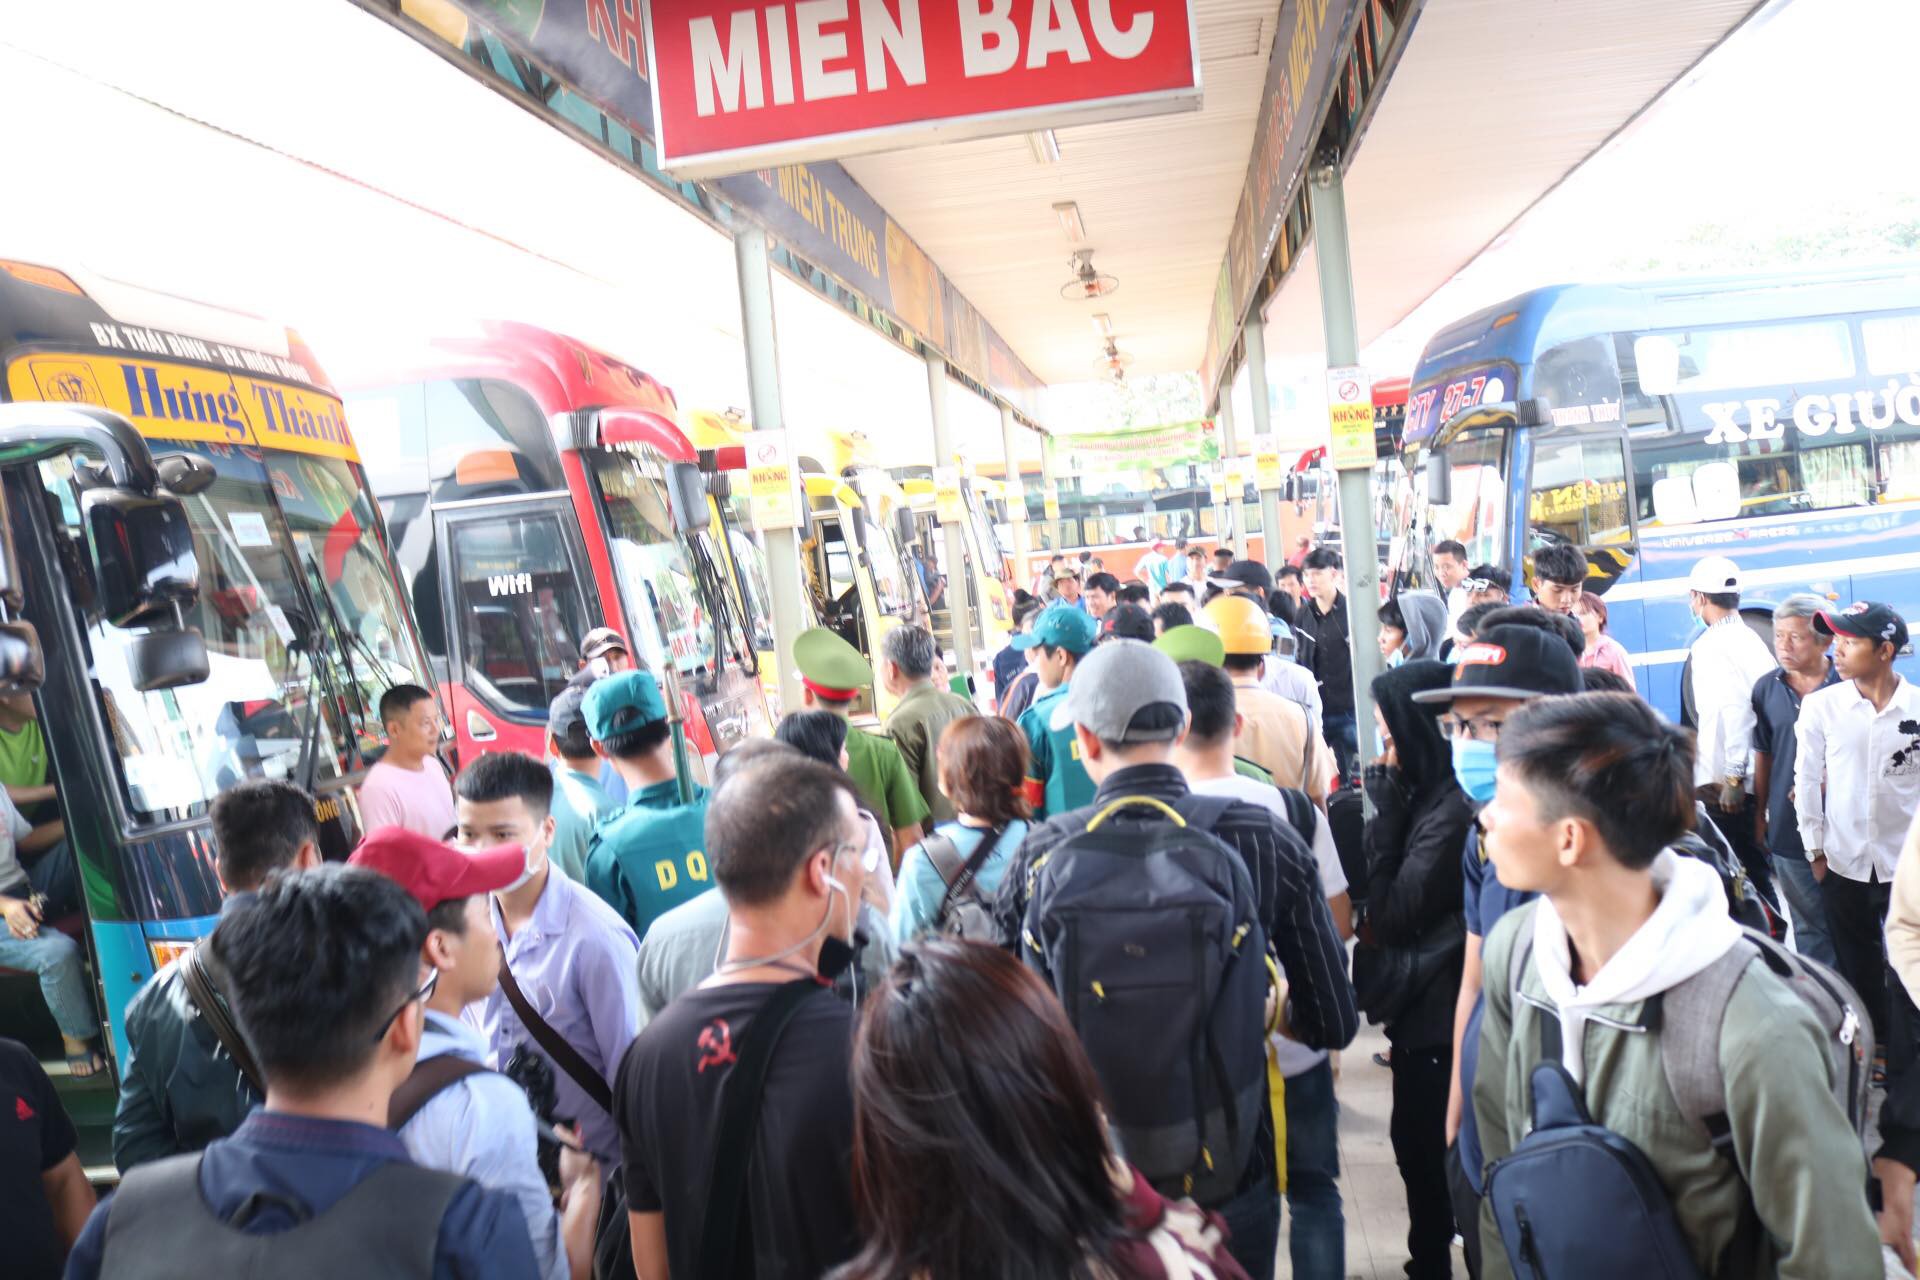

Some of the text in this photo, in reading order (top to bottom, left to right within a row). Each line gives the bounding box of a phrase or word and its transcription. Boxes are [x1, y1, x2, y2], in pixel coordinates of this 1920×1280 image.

[826, 188, 880, 278] TRUNG
[90, 322, 124, 349] BX
[121, 326, 164, 356] THÁI
[217, 345, 244, 369] BX
[119, 364, 352, 447] Hưng Thành
[1406, 376, 1486, 434] CTY 27-7
[1702, 399, 1785, 444] XE
[1881, 622, 1897, 641] 2
